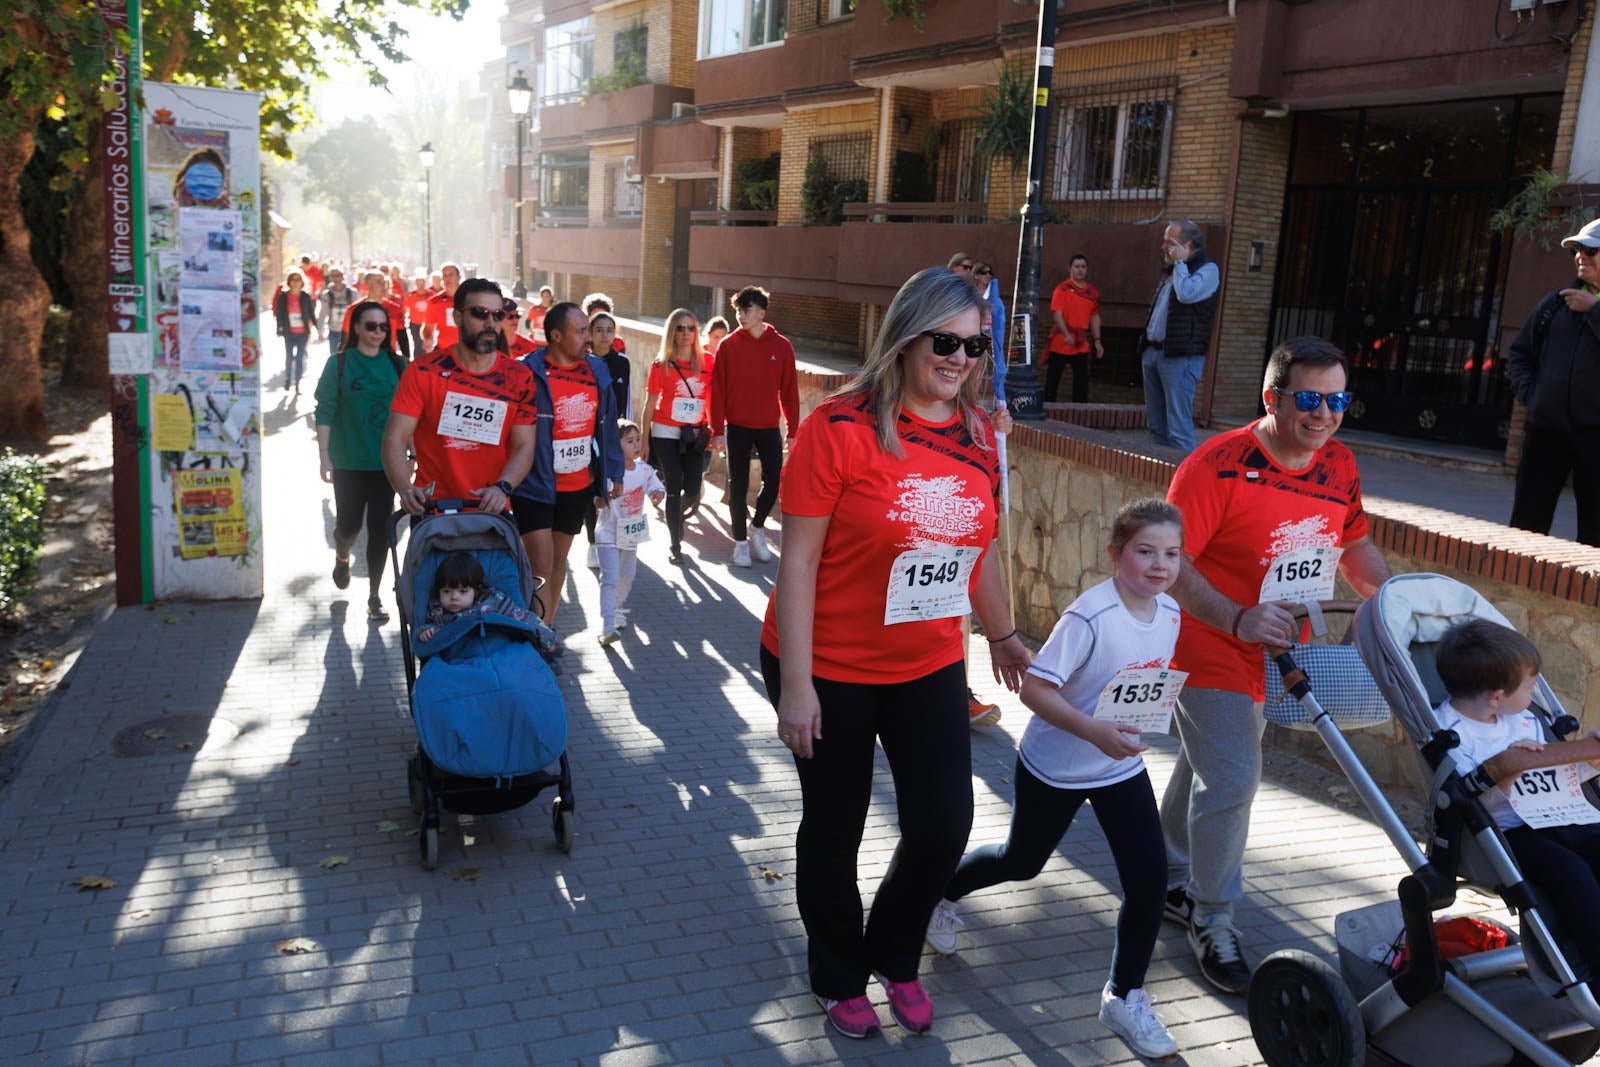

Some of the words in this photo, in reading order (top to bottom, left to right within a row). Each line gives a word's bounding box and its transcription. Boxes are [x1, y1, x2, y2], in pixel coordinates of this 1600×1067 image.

[106, 42, 128, 158] Saluable
[1423, 158, 1434, 178] 2
[108, 164, 130, 264] Itinerarios
[453, 403, 495, 423] 1256
[683, 402, 695, 411] 79
[559, 445, 585, 459] 1498
[901, 491, 976, 517] carrera
[1272, 536, 1332, 551] carrera
[904, 560, 960, 587] 1549
[1274, 558, 1323, 583] 1562
[1111, 682, 1165, 704] 1535
[1512, 769, 1561, 796] 1537
